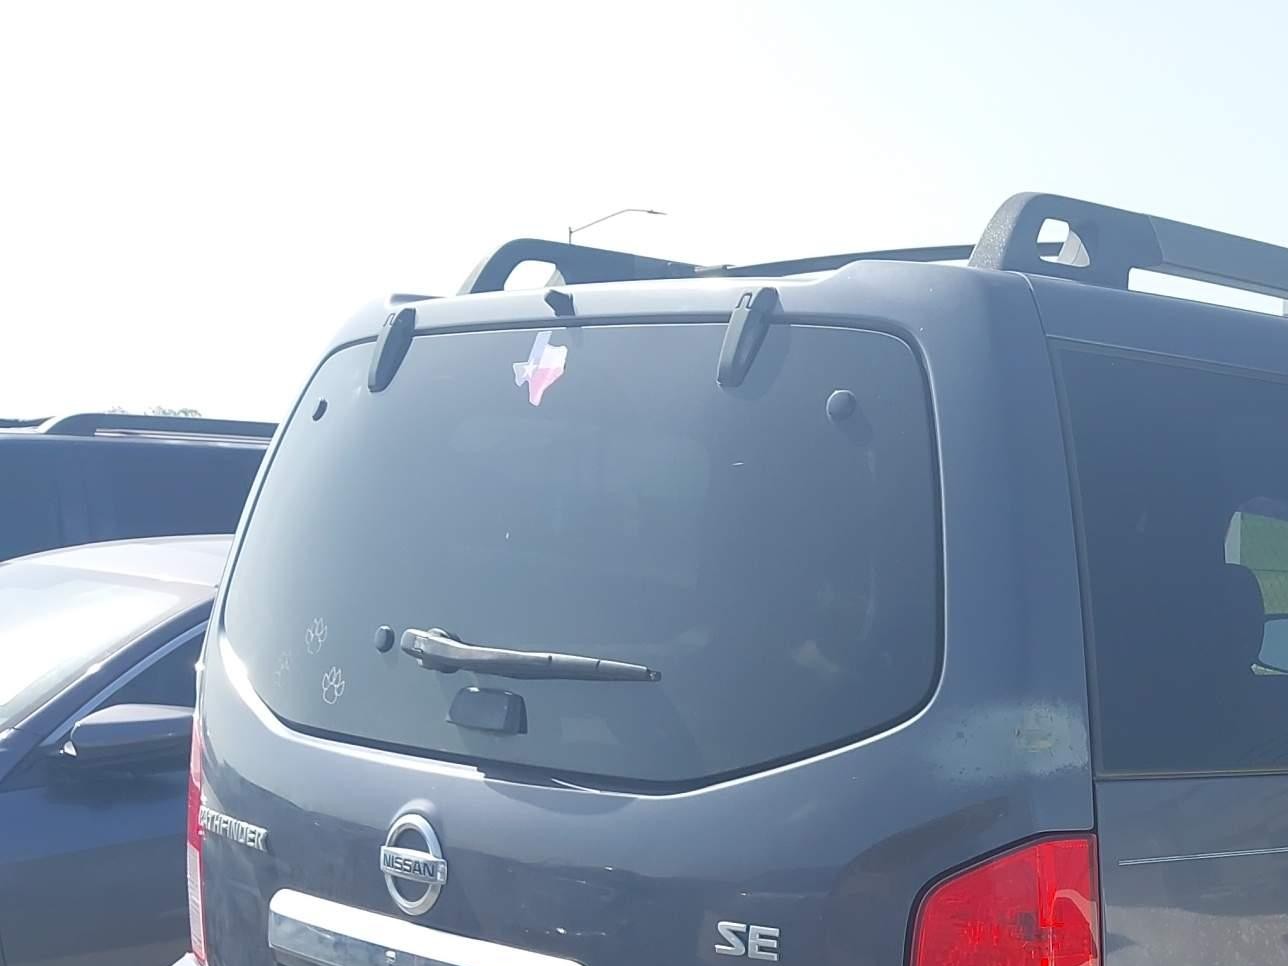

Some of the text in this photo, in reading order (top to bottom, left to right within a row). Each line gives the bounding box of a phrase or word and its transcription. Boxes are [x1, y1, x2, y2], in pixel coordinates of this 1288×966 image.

[198, 805, 268, 852] PATHFINDER
[383, 853, 435, 877] NISSAN
[714, 920, 781, 962] SE
